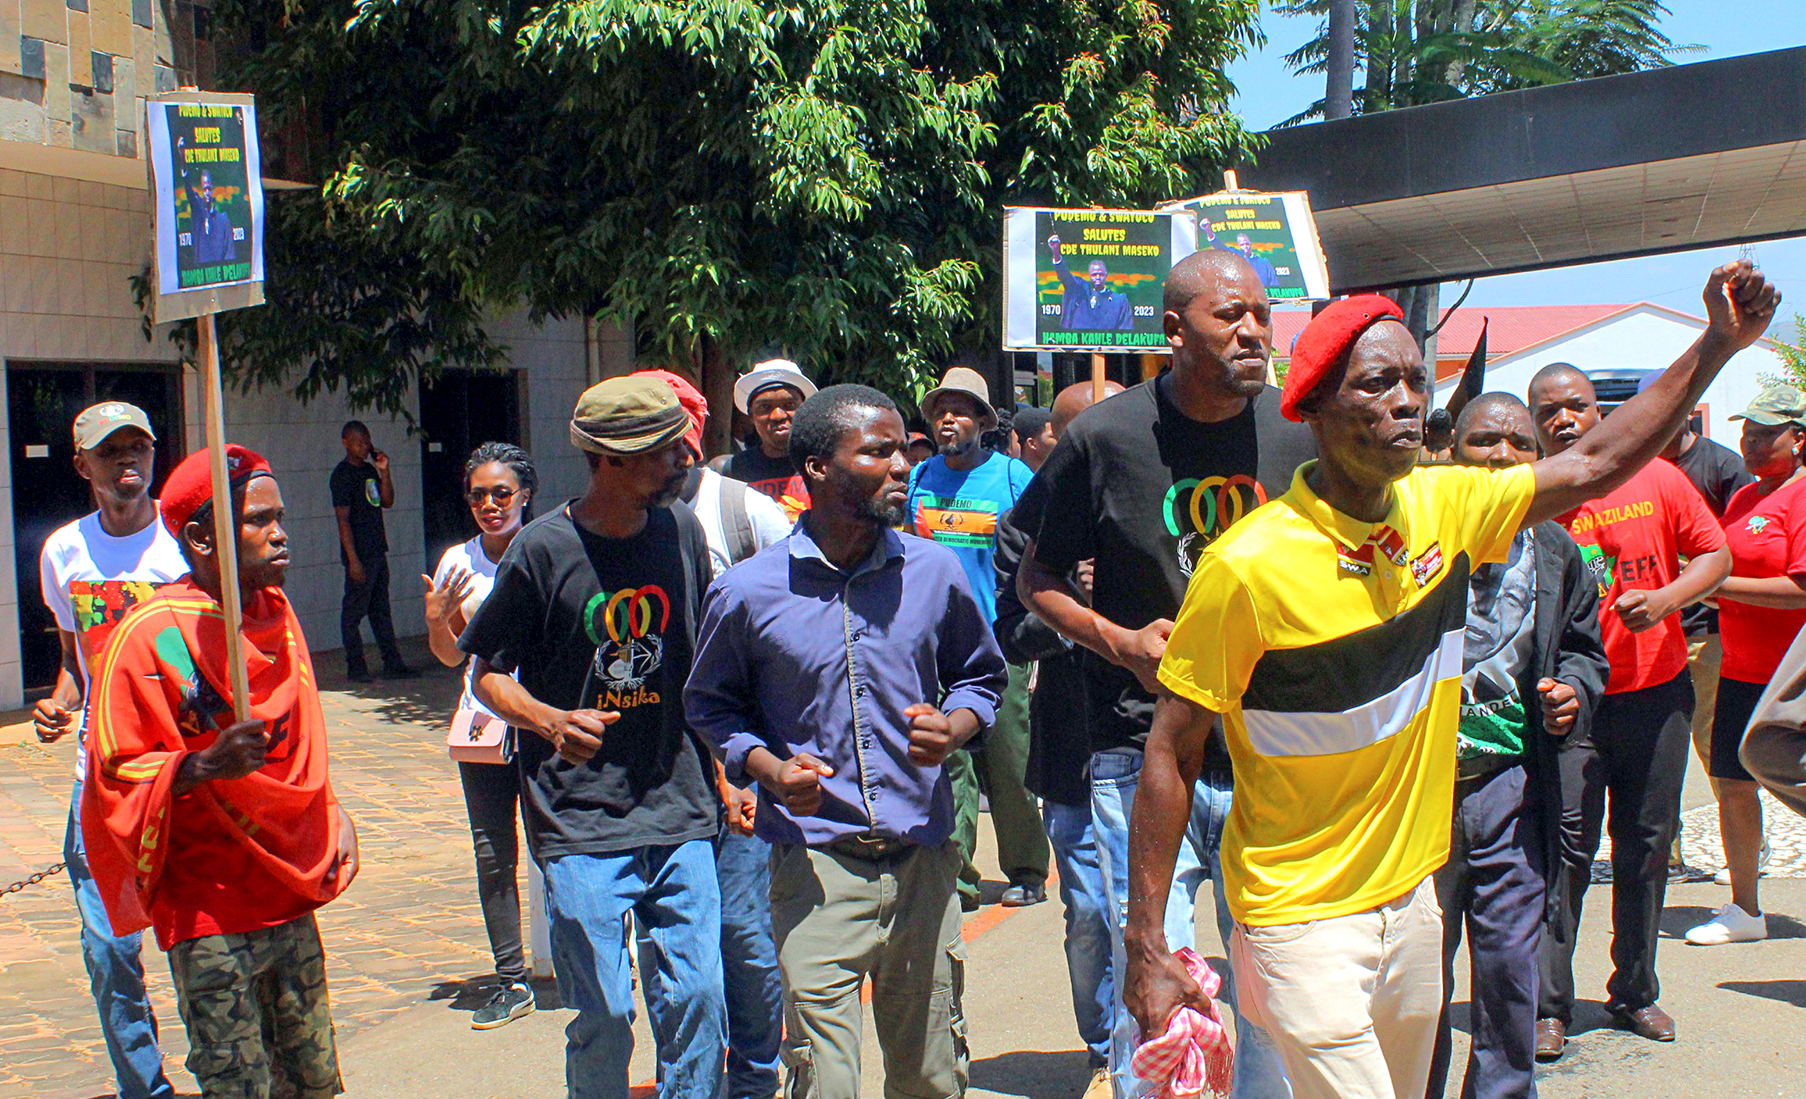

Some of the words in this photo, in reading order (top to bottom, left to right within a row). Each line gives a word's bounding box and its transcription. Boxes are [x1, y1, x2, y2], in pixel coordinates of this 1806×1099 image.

[1083, 228, 1126, 241] SALUTES
[1060, 243, 1078, 255] CDE
[1079, 244, 1120, 256] THULANI
[1122, 245, 1160, 257] MASEKO
[1041, 304, 1061, 316] 1970
[1133, 305, 1155, 317] 2023
[1042, 331, 1079, 345] HAMBA
[1081, 332, 1112, 345] KAHLE
[1115, 332, 1166, 346] DELAKUFA
[940, 498, 973, 509] PUDEMO
[1571, 501, 1654, 534] SWAZILAND
[597, 686, 660, 710] iNsika
